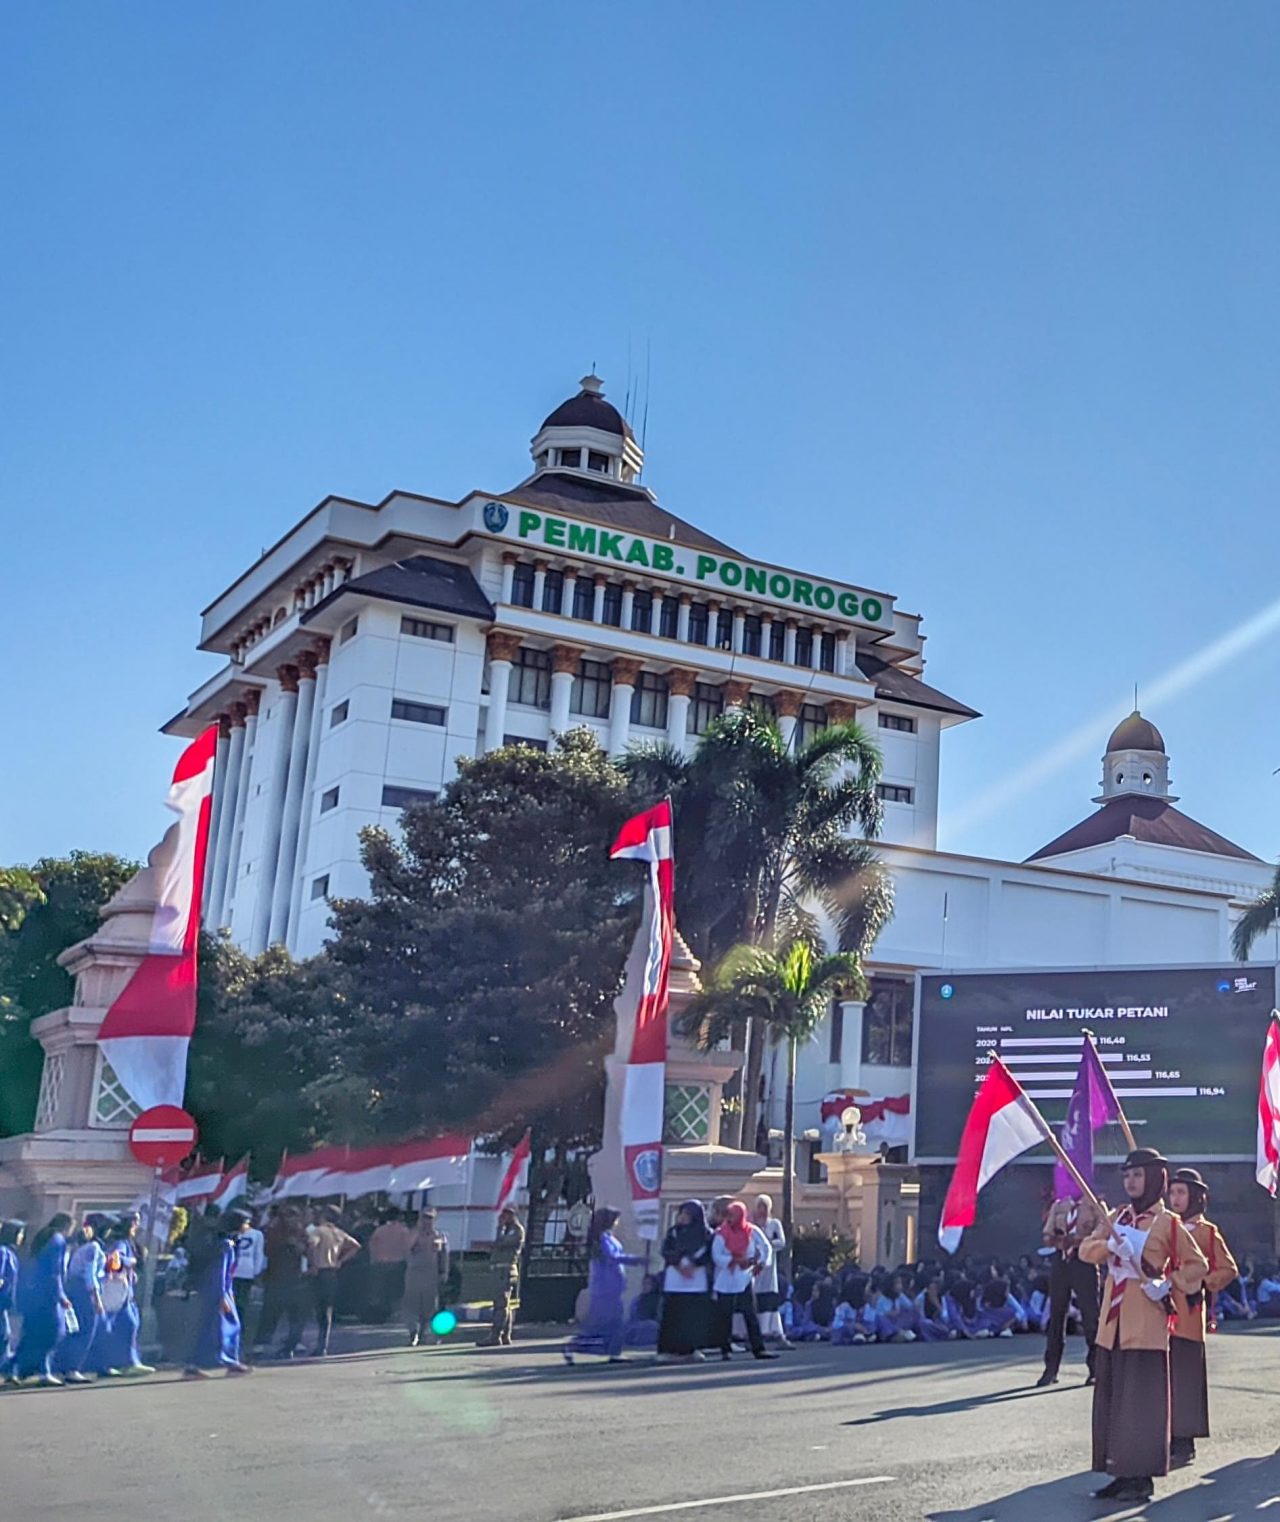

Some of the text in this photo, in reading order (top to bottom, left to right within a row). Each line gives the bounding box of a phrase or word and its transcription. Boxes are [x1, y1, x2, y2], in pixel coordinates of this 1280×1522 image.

[518, 511, 882, 622] PEMKAB. PONOROGO
[1026, 1006, 1169, 1020] NILAI TUKAR PETANI
[976, 1039, 998, 1047] 2020
[1126, 1053, 1151, 1062] 116,53
[1154, 1070, 1180, 1079] 116,65
[1199, 1087, 1225, 1096] 116,94
